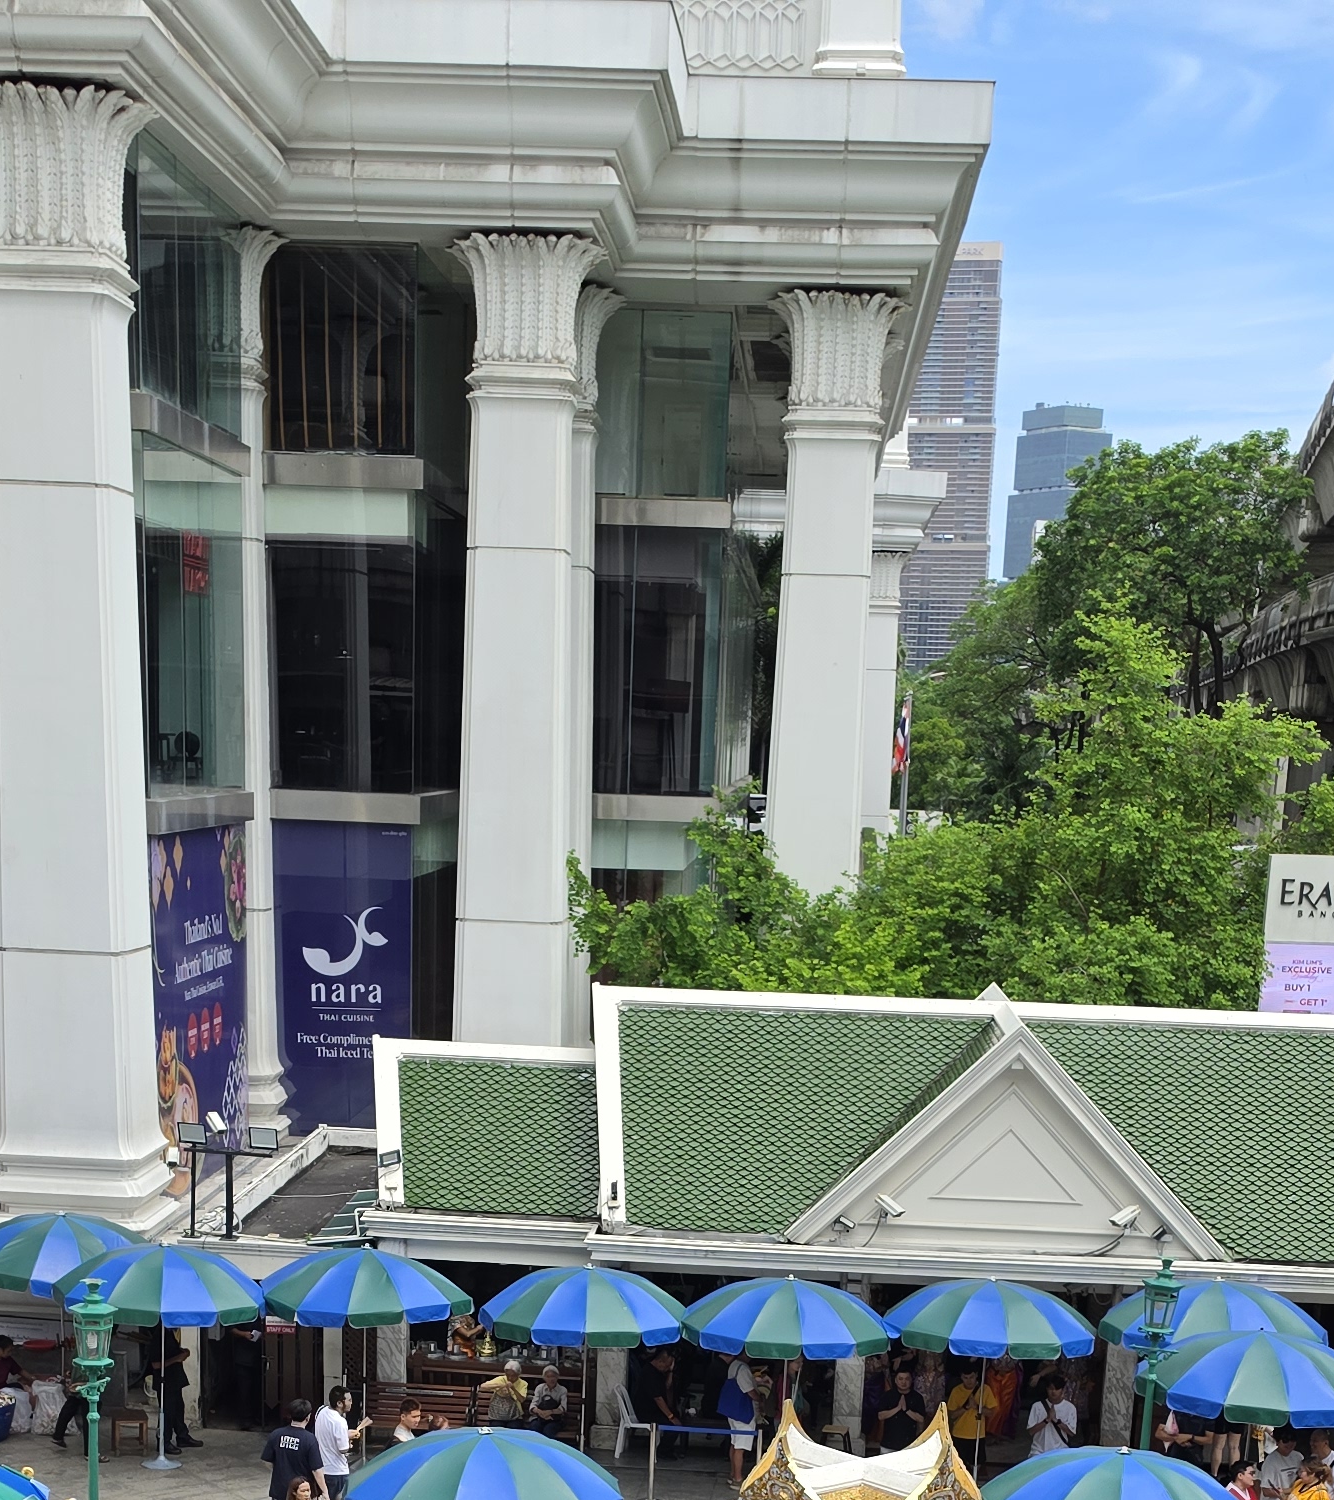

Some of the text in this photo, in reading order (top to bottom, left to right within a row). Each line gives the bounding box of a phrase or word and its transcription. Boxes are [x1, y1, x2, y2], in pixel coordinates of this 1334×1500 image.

[1281, 965, 1332, 974] EXCLUSIVE
[311, 982, 382, 1004] nara
[319, 1013, 375, 1022] THAI CUISINE
[297, 1032, 373, 1047] Free Complime
[315, 1046, 373, 1059] Thai Iced Te
